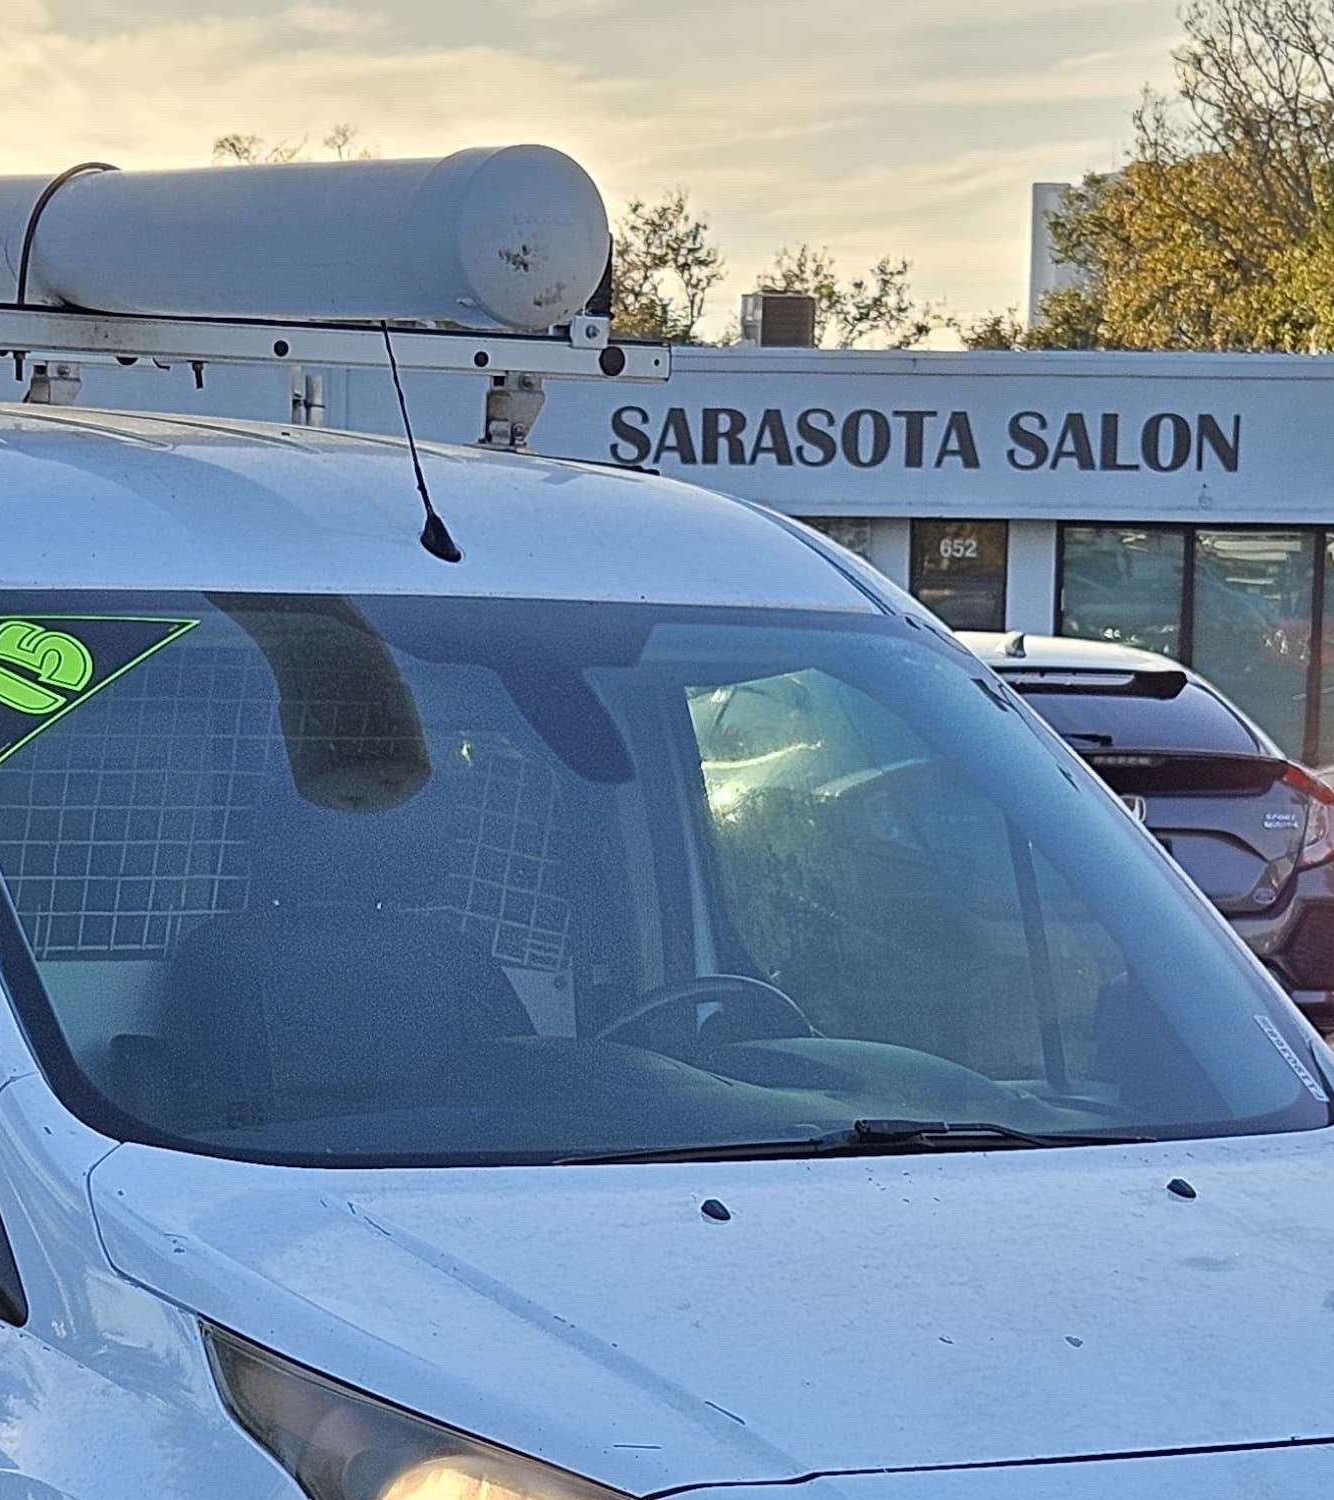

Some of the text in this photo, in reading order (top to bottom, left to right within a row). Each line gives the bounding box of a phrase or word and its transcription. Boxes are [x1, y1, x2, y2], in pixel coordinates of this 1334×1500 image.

[609, 405, 1241, 473] SARASOTA SALON
[939, 537, 978, 558] 652
